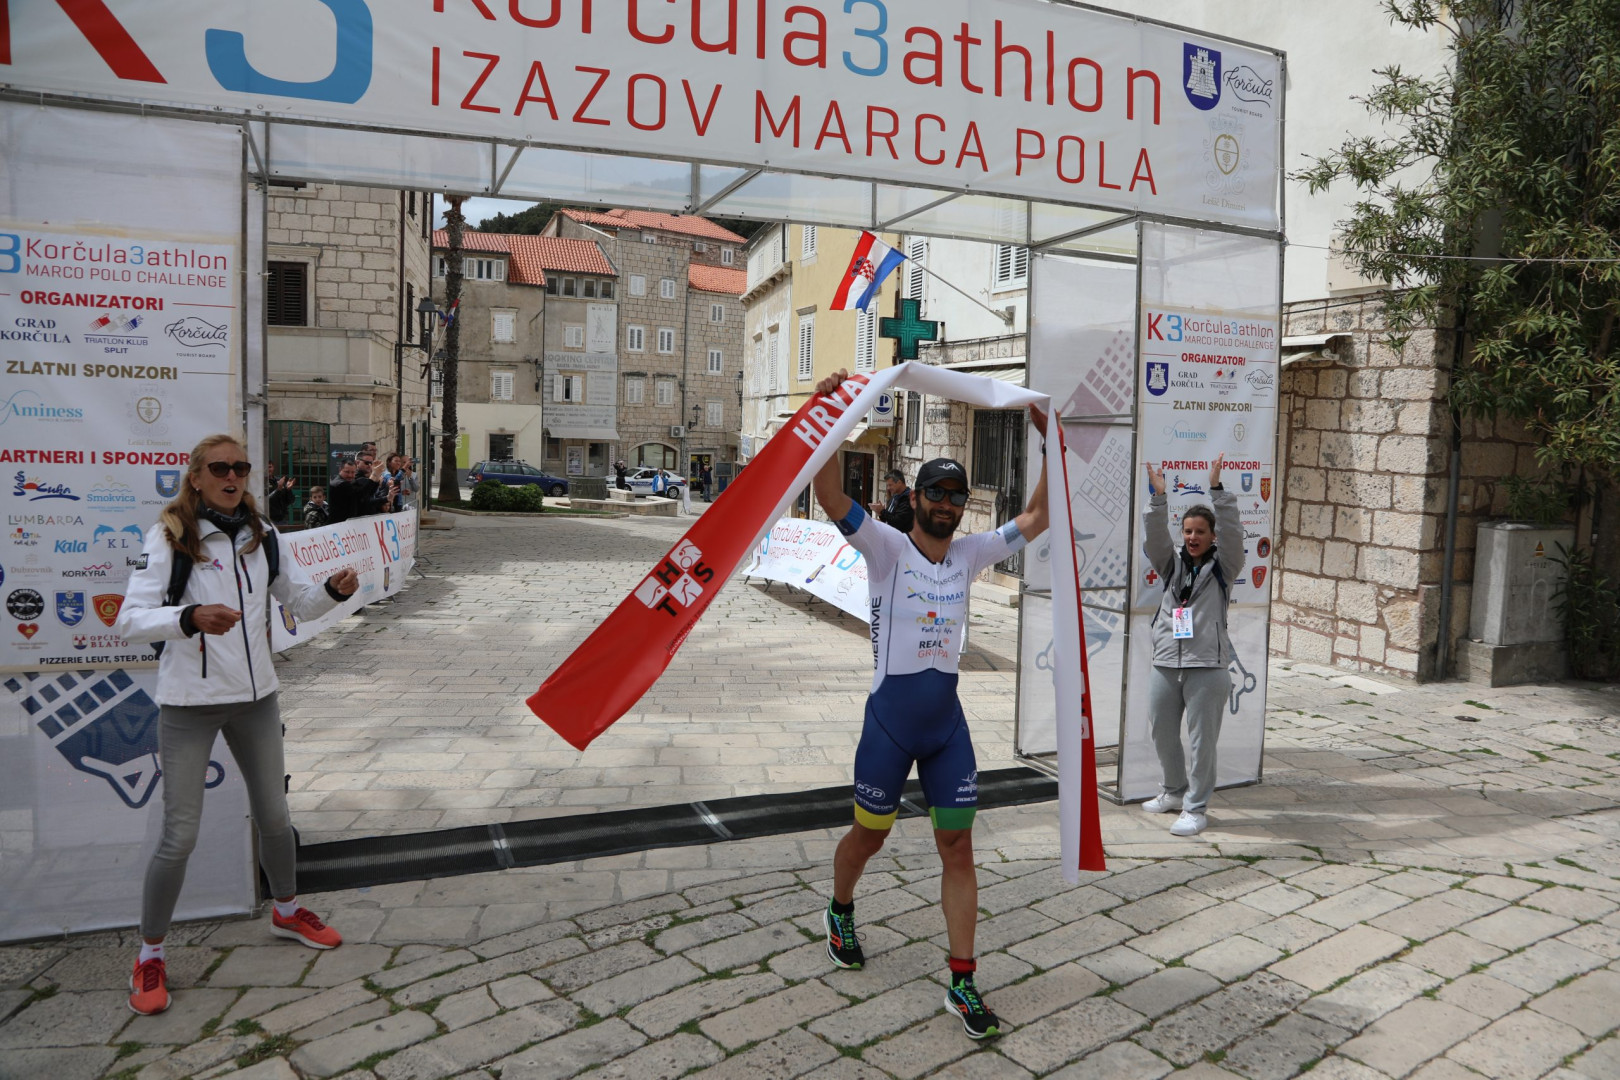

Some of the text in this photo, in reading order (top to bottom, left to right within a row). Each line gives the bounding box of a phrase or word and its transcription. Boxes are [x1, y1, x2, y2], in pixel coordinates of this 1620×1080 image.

[1223, 66, 1273, 102] Korčula
[432, 46, 722, 137] IZAZOV
[754, 89, 989, 173] MARCA
[1015, 127, 1158, 196] POLA
[26, 238, 227, 270] Korčula3athlon
[26, 264, 227, 288] MARCO POLO CHALLENGE
[20, 290, 164, 311] ORGANIZATORI
[15, 317, 56, 329] GRAD
[1147, 312, 1274, 342] K3 Korčula3athlon
[0, 330, 71, 344] KORČULA
[164, 317, 228, 345] Korčula
[84, 337, 148, 346] TRIATLON KLUB
[1184, 335, 1274, 350] MARCO POLO CHALLENGE
[1181, 352, 1246, 366] ORGANIZATORI
[6, 360, 178, 380] ZLATNI SPONZORI
[1178, 371, 1198, 379] GRAD
[1170, 379, 1204, 389] KORČULA
[1173, 400, 1252, 412] ZLATNI SPONZORI
[90, 451, 96, 464] I
[1161, 460, 1208, 471] PARTNERI
[87, 493, 136, 502] Smokvica
[8, 515, 84, 526] LUMBARDA
[54, 540, 88, 553] Kala
[374, 519, 400, 565] K3
[290, 531, 371, 568] Korčula3athlon
[656, 561, 680, 585] H
[694, 562, 714, 584] S
[656, 597, 677, 617] T
[919, 640, 943, 649] REAL
[40, 657, 83, 665] PIZZERIE
[86, 655, 111, 664] LEUT,
[114, 655, 139, 663] STEP,
